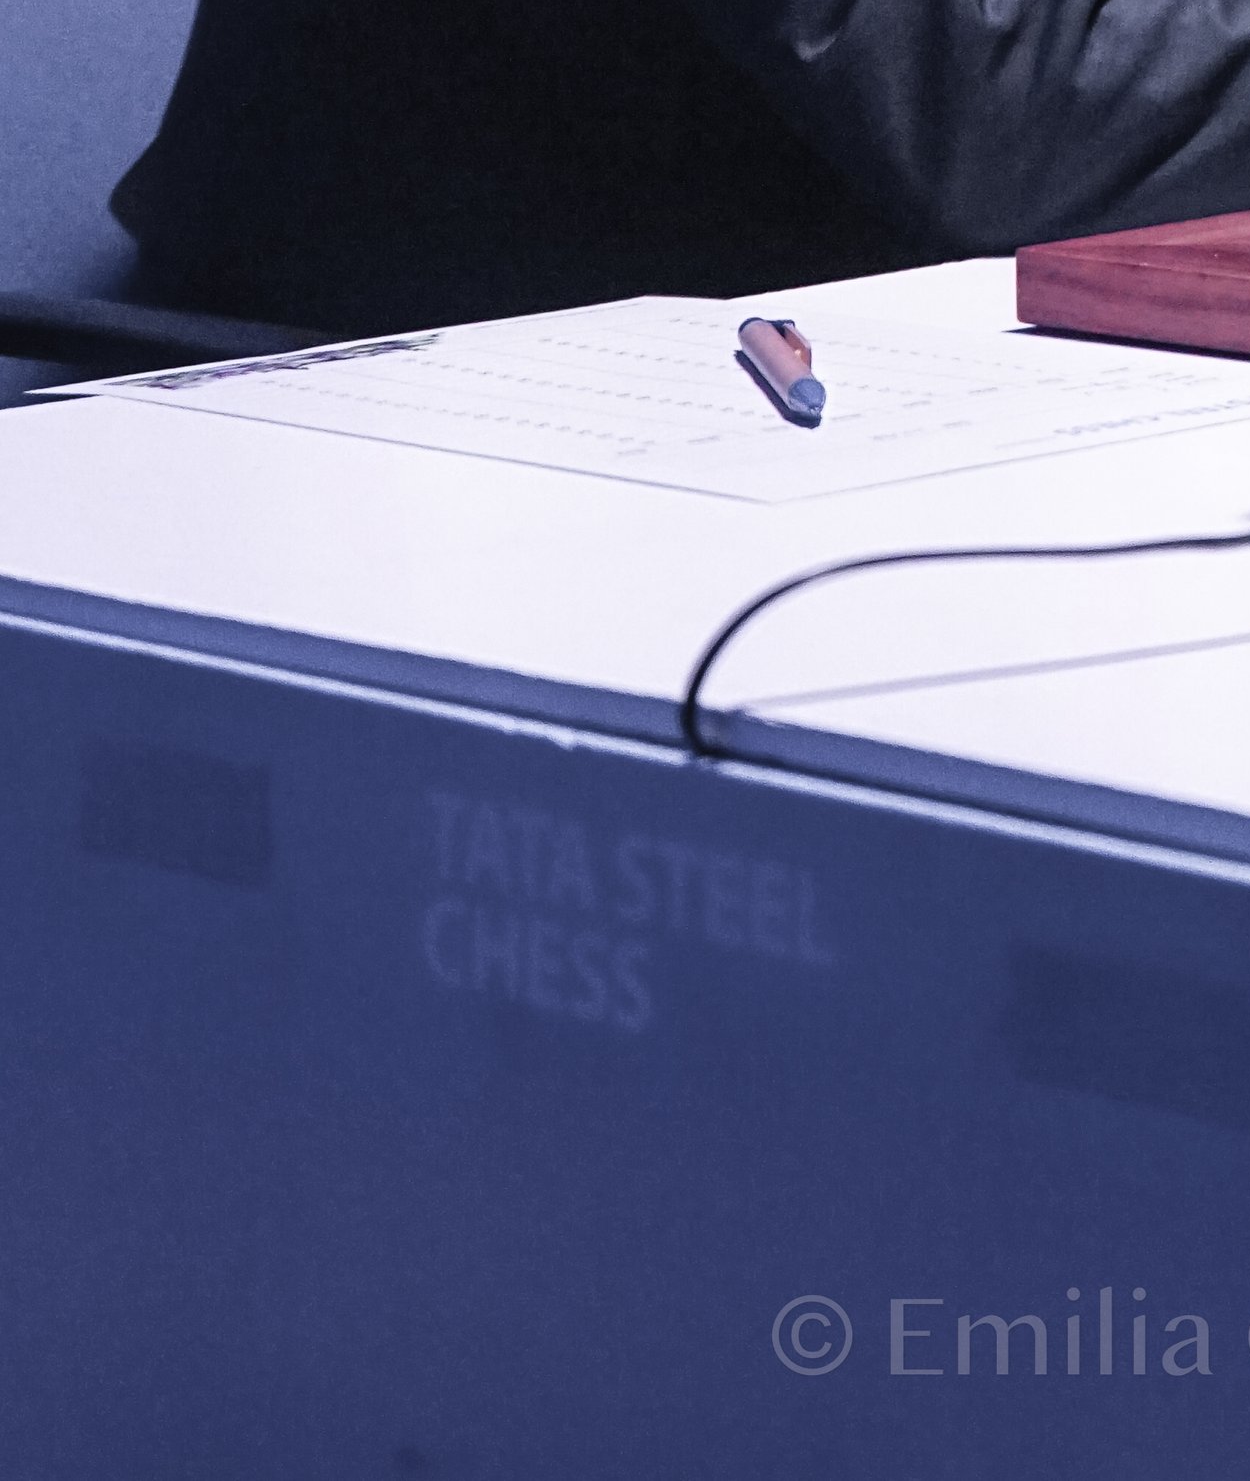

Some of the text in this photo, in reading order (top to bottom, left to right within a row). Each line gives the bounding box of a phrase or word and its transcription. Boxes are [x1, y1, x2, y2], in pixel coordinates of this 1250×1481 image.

[428, 790, 838, 968] TATA STEEL
[424, 898, 653, 1034] CHESS
